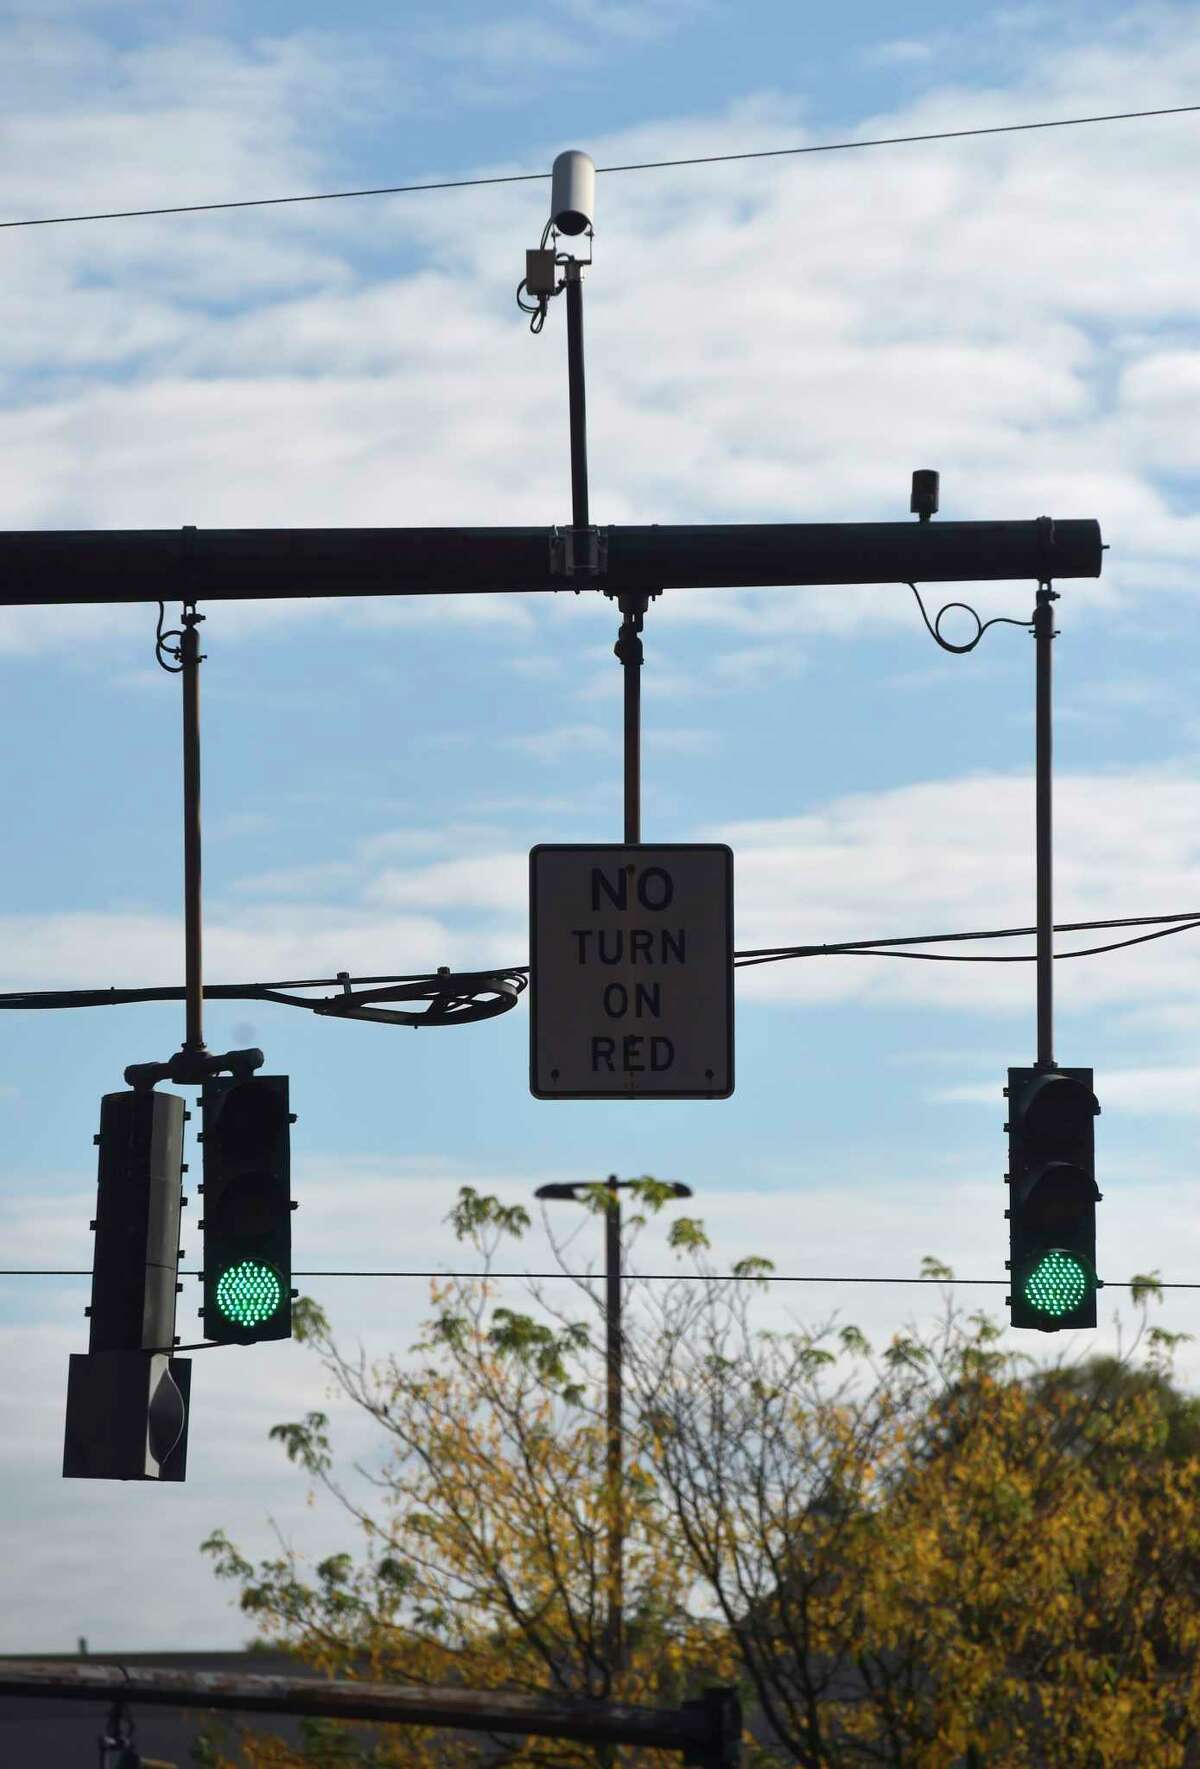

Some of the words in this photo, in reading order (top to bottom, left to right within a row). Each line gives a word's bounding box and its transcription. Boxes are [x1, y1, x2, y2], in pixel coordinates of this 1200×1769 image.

[591, 867, 674, 911] NO
[571, 929, 686, 965] TURN
[603, 982, 661, 1018] ON
[591, 1036, 675, 1072] RED
